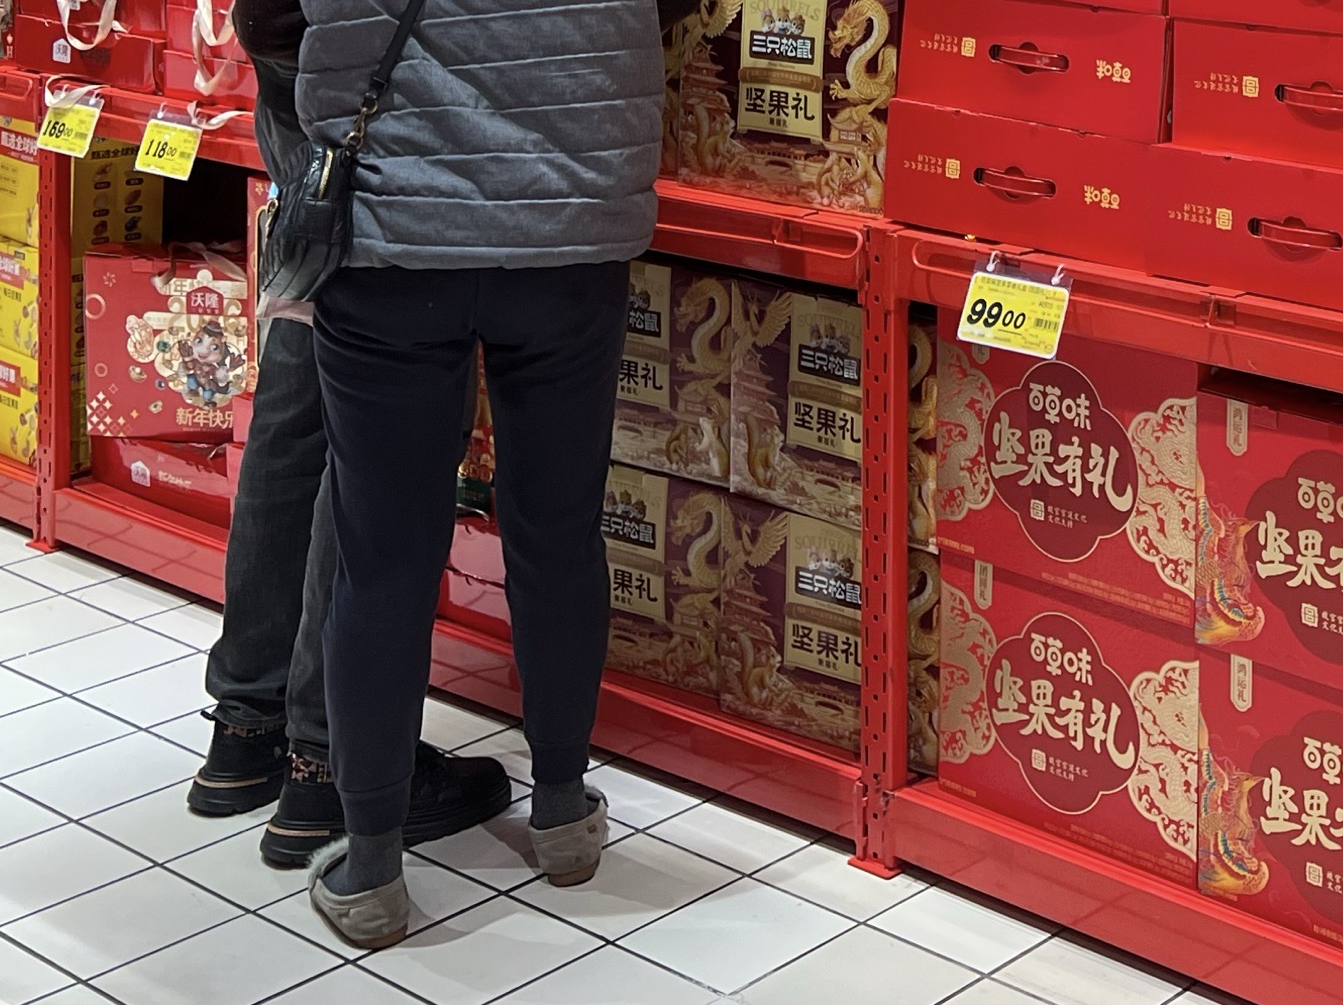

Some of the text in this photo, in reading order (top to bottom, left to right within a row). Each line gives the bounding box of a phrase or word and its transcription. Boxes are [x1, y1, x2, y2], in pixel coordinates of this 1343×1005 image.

[752, 34, 812, 59] 三只松鼠
[1096, 59, 1132, 83] 百草味
[745, 87, 815, 121] 坚果礼
[1084, 185, 1120, 209] 百草味
[190, 293, 220, 308] 沃隆
[801, 349, 858, 380] 三只松鼠
[176, 407, 234, 428] 新年快乐
[794, 401, 861, 444] 坚果礼
[1029, 383, 1091, 430] 百草味
[991, 412, 1133, 512] 坚果有礼
[798, 572, 861, 605] 三只松鼠
[1030, 633, 1093, 685] 百草味
[992, 659, 1135, 770] 坚果有礼
